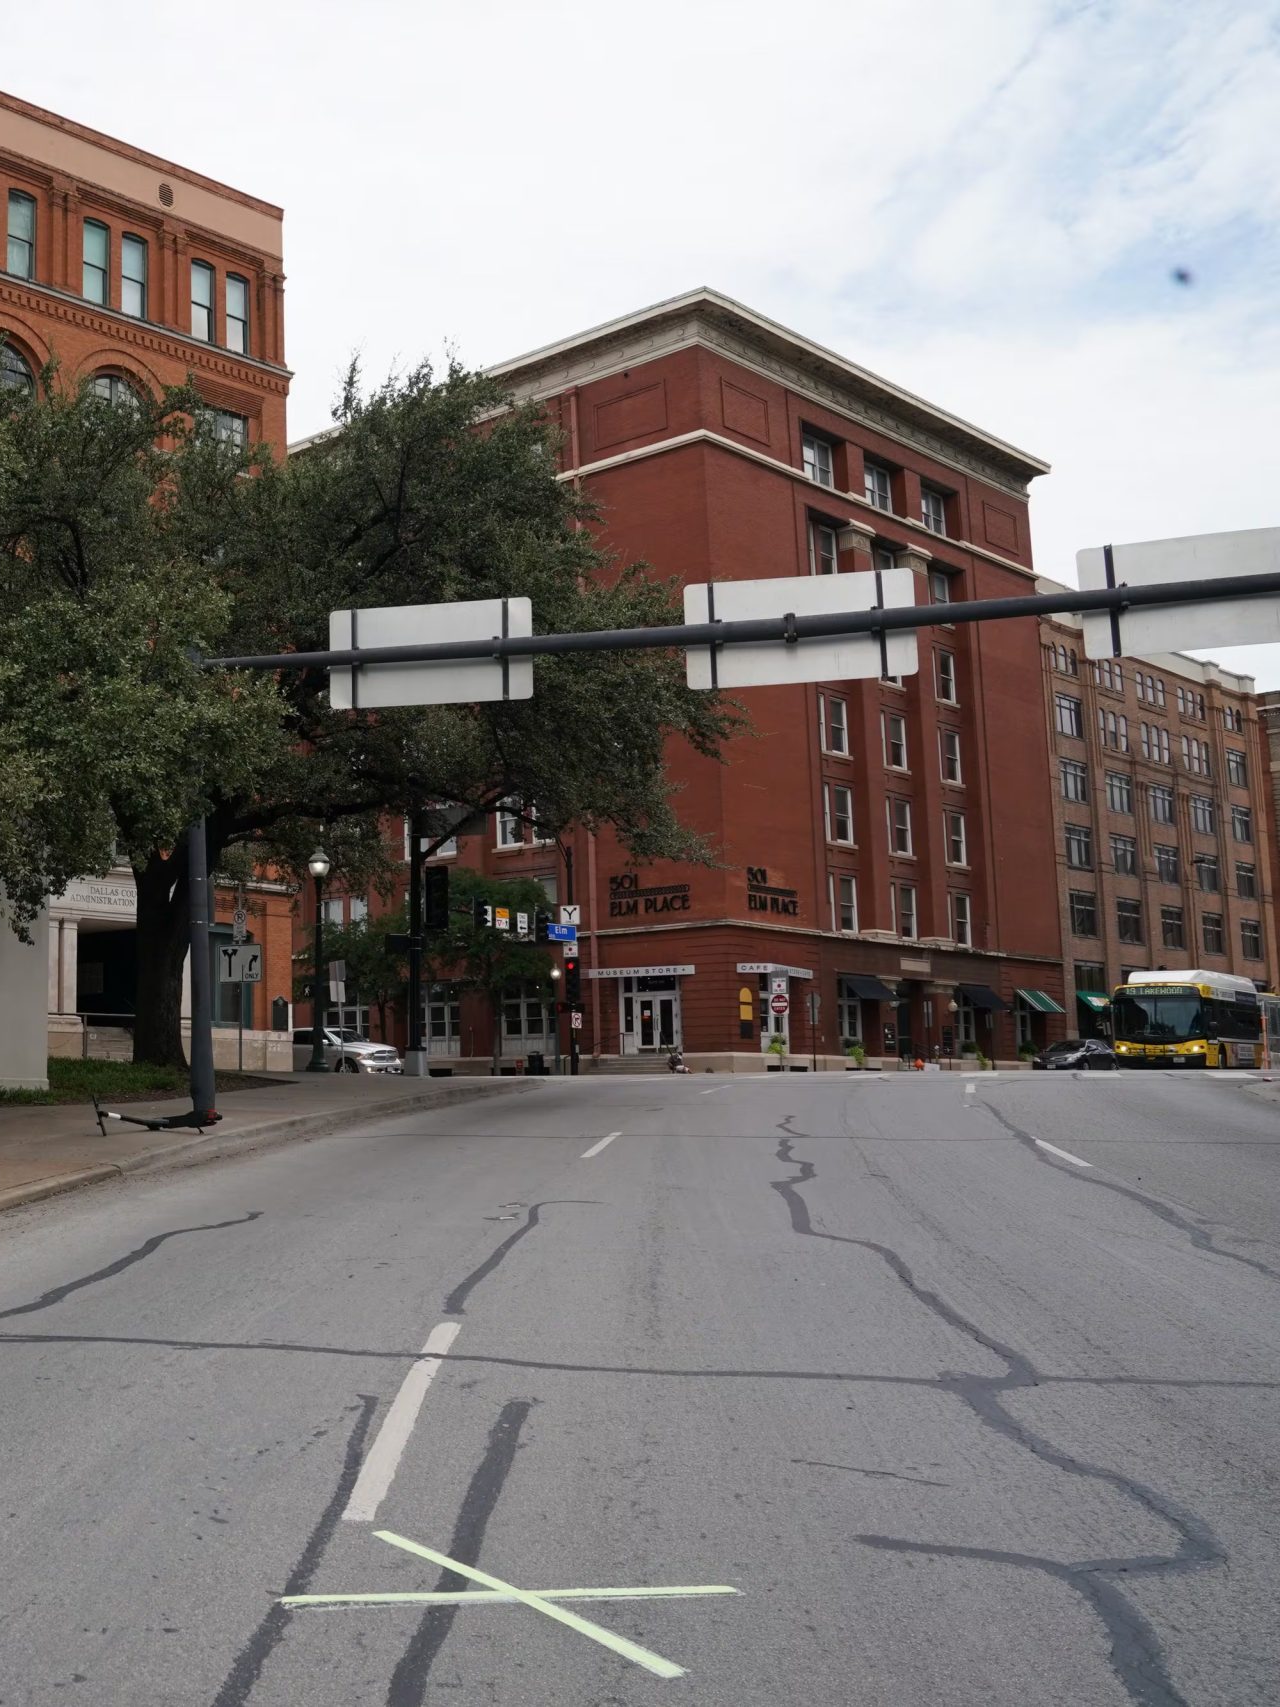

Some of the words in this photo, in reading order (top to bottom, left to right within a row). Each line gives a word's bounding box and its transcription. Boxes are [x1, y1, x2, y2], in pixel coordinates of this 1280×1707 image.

[609, 874, 638, 892] 501
[747, 866, 767, 884] 501
[70, 894, 135, 907] ADMINISTRATION
[90, 886, 119, 897] DALLAS
[121, 889, 137, 899] COU
[610, 899, 639, 917] ELM
[644, 894, 690, 913] PLACE
[748, 894, 768, 911] ELM
[770, 896, 799, 916] PLACE
[555, 926, 568, 935] Elm
